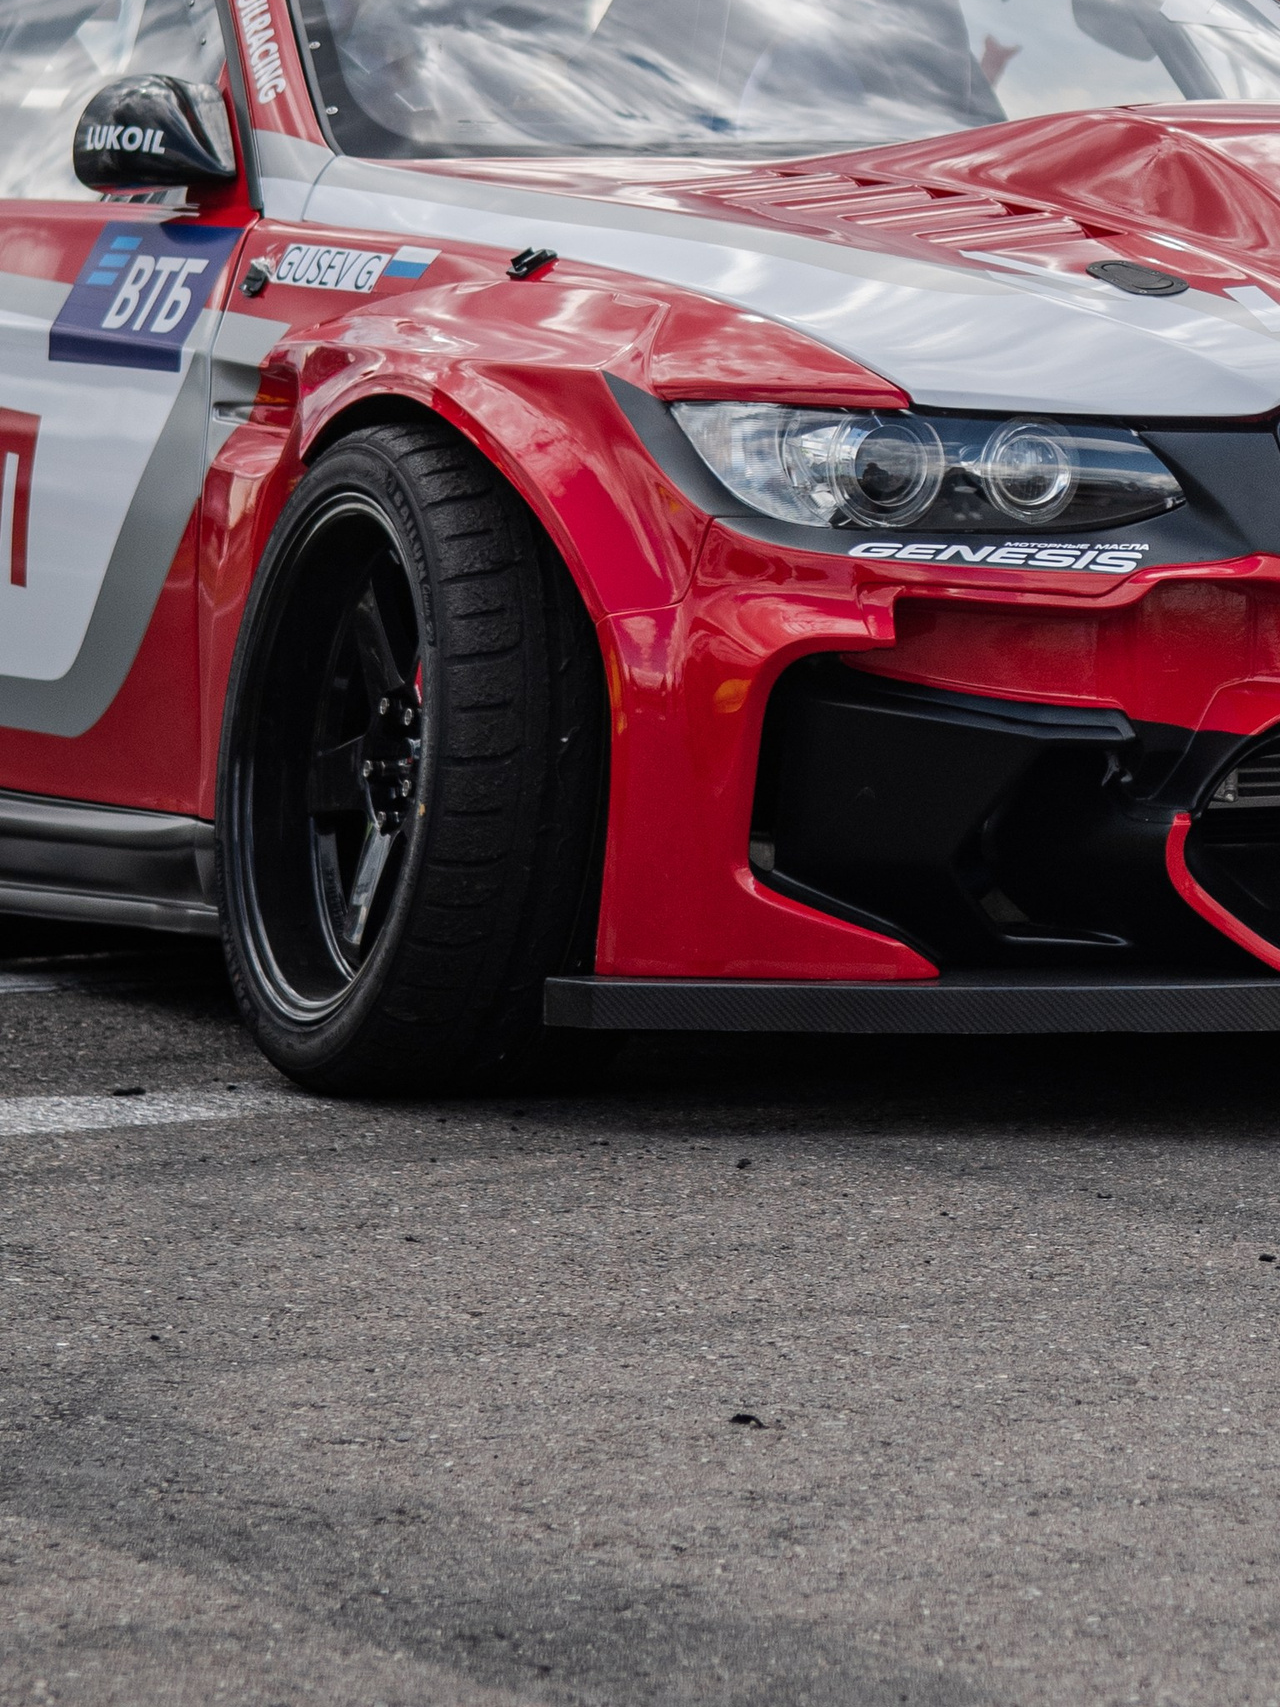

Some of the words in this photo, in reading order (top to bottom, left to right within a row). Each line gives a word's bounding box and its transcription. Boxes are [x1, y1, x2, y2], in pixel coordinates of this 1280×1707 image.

[85, 124, 166, 155] LUKOIL
[275, 245, 357, 285] GUSEV
[101, 255, 209, 334] ВТБ
[848, 542, 1143, 574] GENESIS
[1003, 541, 1091, 550] МОТОРНЫЕ
[1095, 543, 1150, 552] МАСЛА
